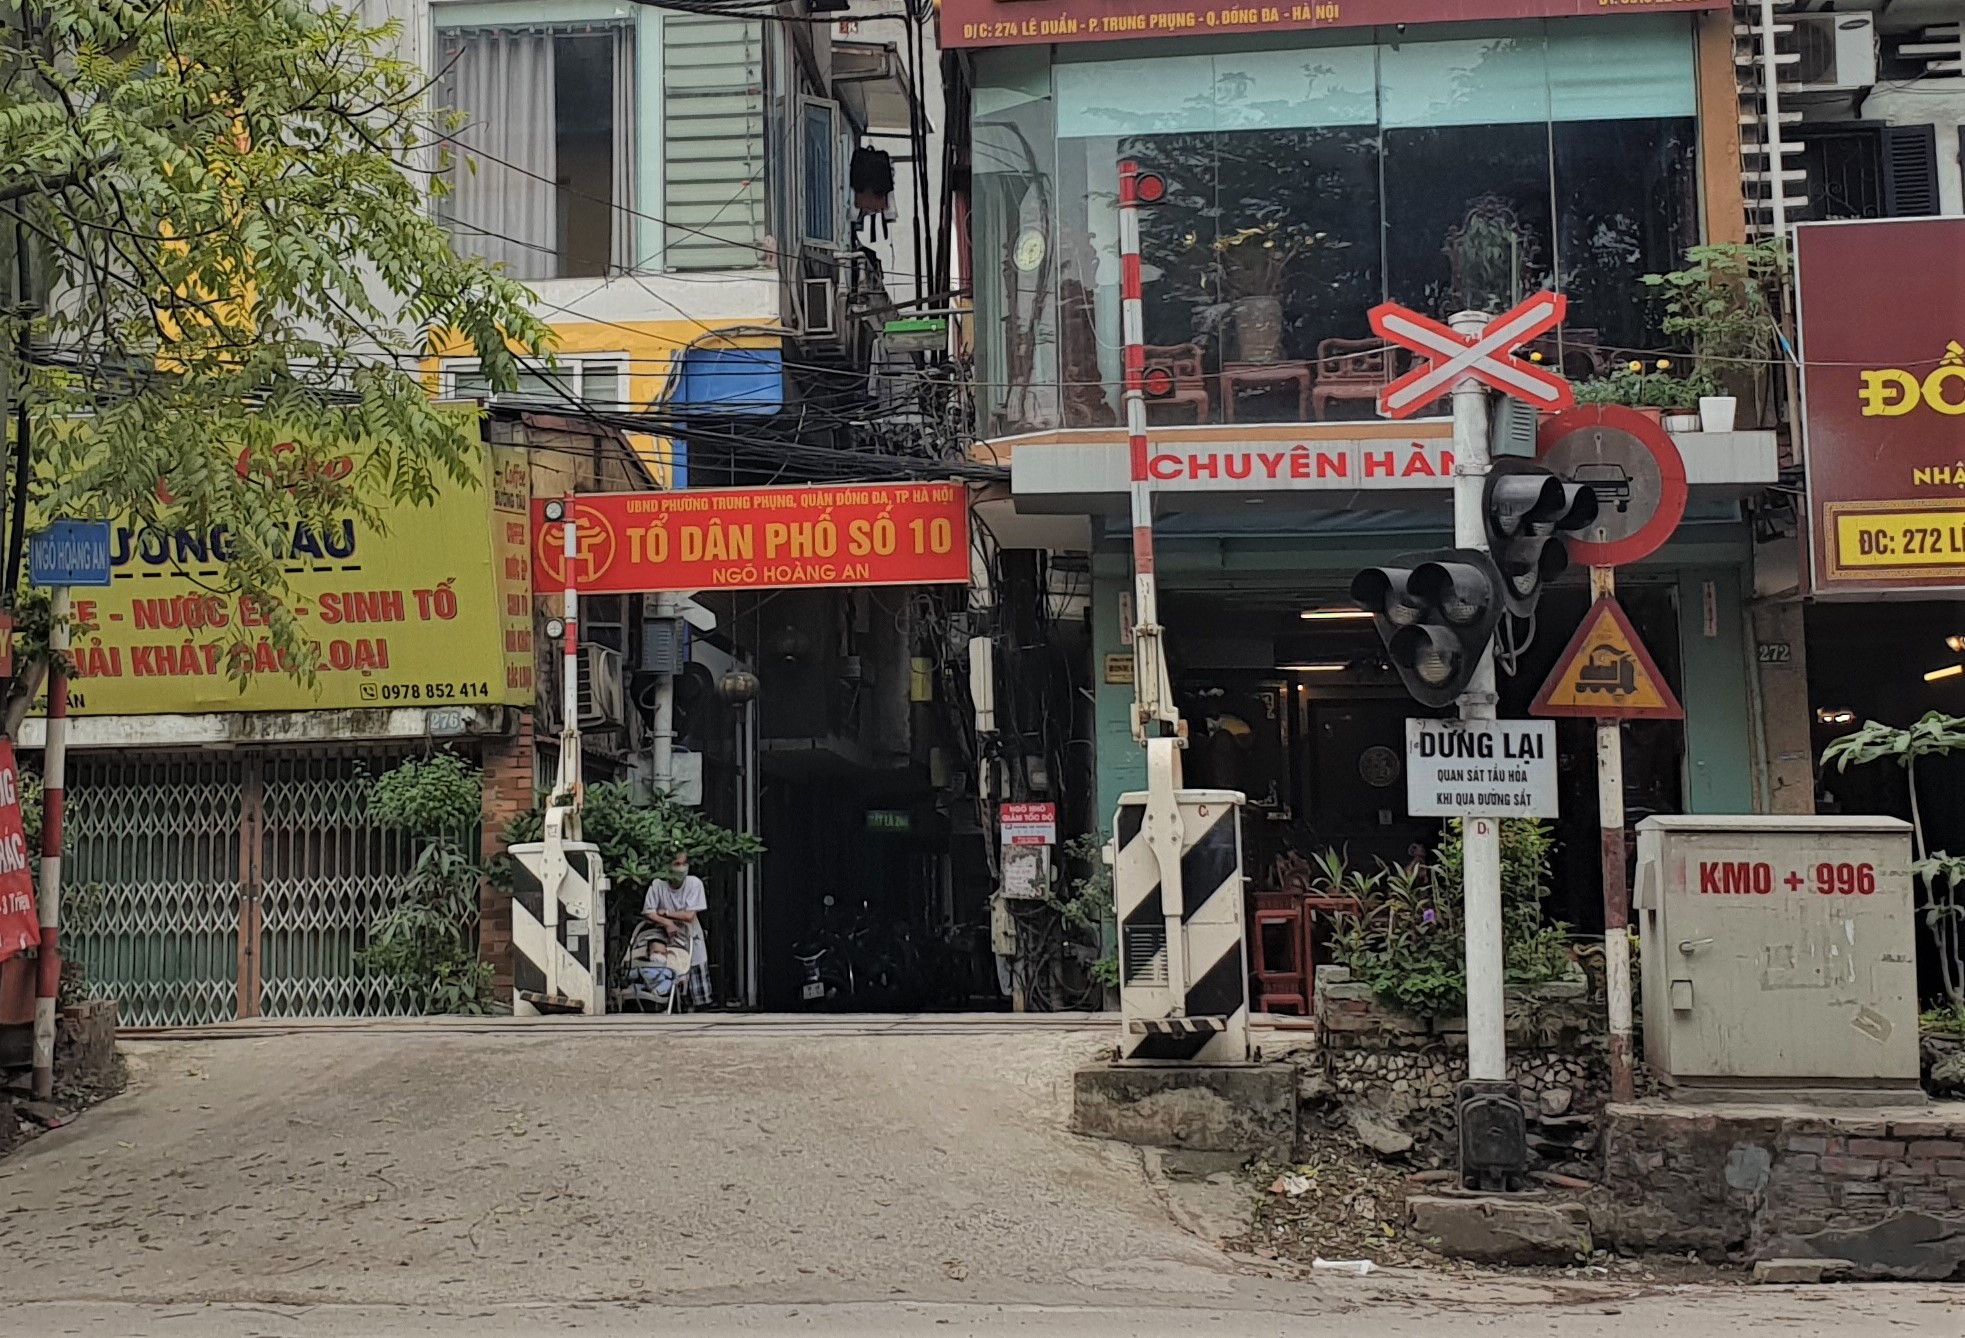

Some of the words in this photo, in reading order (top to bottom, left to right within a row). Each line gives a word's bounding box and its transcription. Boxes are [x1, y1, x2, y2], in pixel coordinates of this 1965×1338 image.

[994, 22, 1018, 38] 274
[1021, 18, 1038, 37] LÊ
[1089, 17, 1101, 33] P.
[1102, 14, 1147, 32] TRUNG
[1150, 11, 1196, 33] PHỤNG
[1292, 2, 1312, 22] HÀ
[1315, 1, 1340, 23] NỘI
[1149, 444, 1348, 481] CHUYÊN
[626, 499, 659, 514] UBND
[661, 494, 709, 512] PHƯỜNG
[711, 496, 751, 510] TRUNG
[800, 490, 833, 509] QUẬN
[894, 489, 910, 504] TP
[912, 487, 930, 503] HÀ
[932, 485, 954, 505] NỘI
[625, 513, 669, 563] TỔ
[680, 517, 753, 562] DÂN
[765, 506, 838, 559] PHỐ
[849, 504, 896, 556] SỐ
[908, 517, 953, 555] 10
[1859, 528, 1897, 556] ĐC:
[1902, 527, 1943, 554] 272
[34, 534, 57, 570] NGÕ
[57, 534, 91, 570] HOÀNG
[92, 541, 106, 570] AN
[712, 564, 758, 583] NGÕ
[763, 561, 837, 582] HOÀNG
[841, 563, 870, 580] AN
[132, 591, 229, 630] NƯỚC
[319, 590, 406, 624] SINH
[412, 577, 458, 621] TỐ
[131, 638, 221, 677] KHÁT
[1759, 644, 1791, 661] 272
[381, 684, 421, 700] 0978
[425, 683, 455, 699] 852
[459, 682, 489, 698] 414
[430, 712, 459, 729] 276
[1502, 732, 1544, 765] LẠI
[1437, 769, 1464, 783] QUAN
[1466, 764, 1485, 782] SÁT
[1508, 764, 1528, 783] HỎA
[1436, 792, 1453, 805] KHI
[1455, 792, 1475, 806] QUA
[1477, 788, 1511, 806] ĐƯỜNG
[1815, 862, 1876, 895] 996
